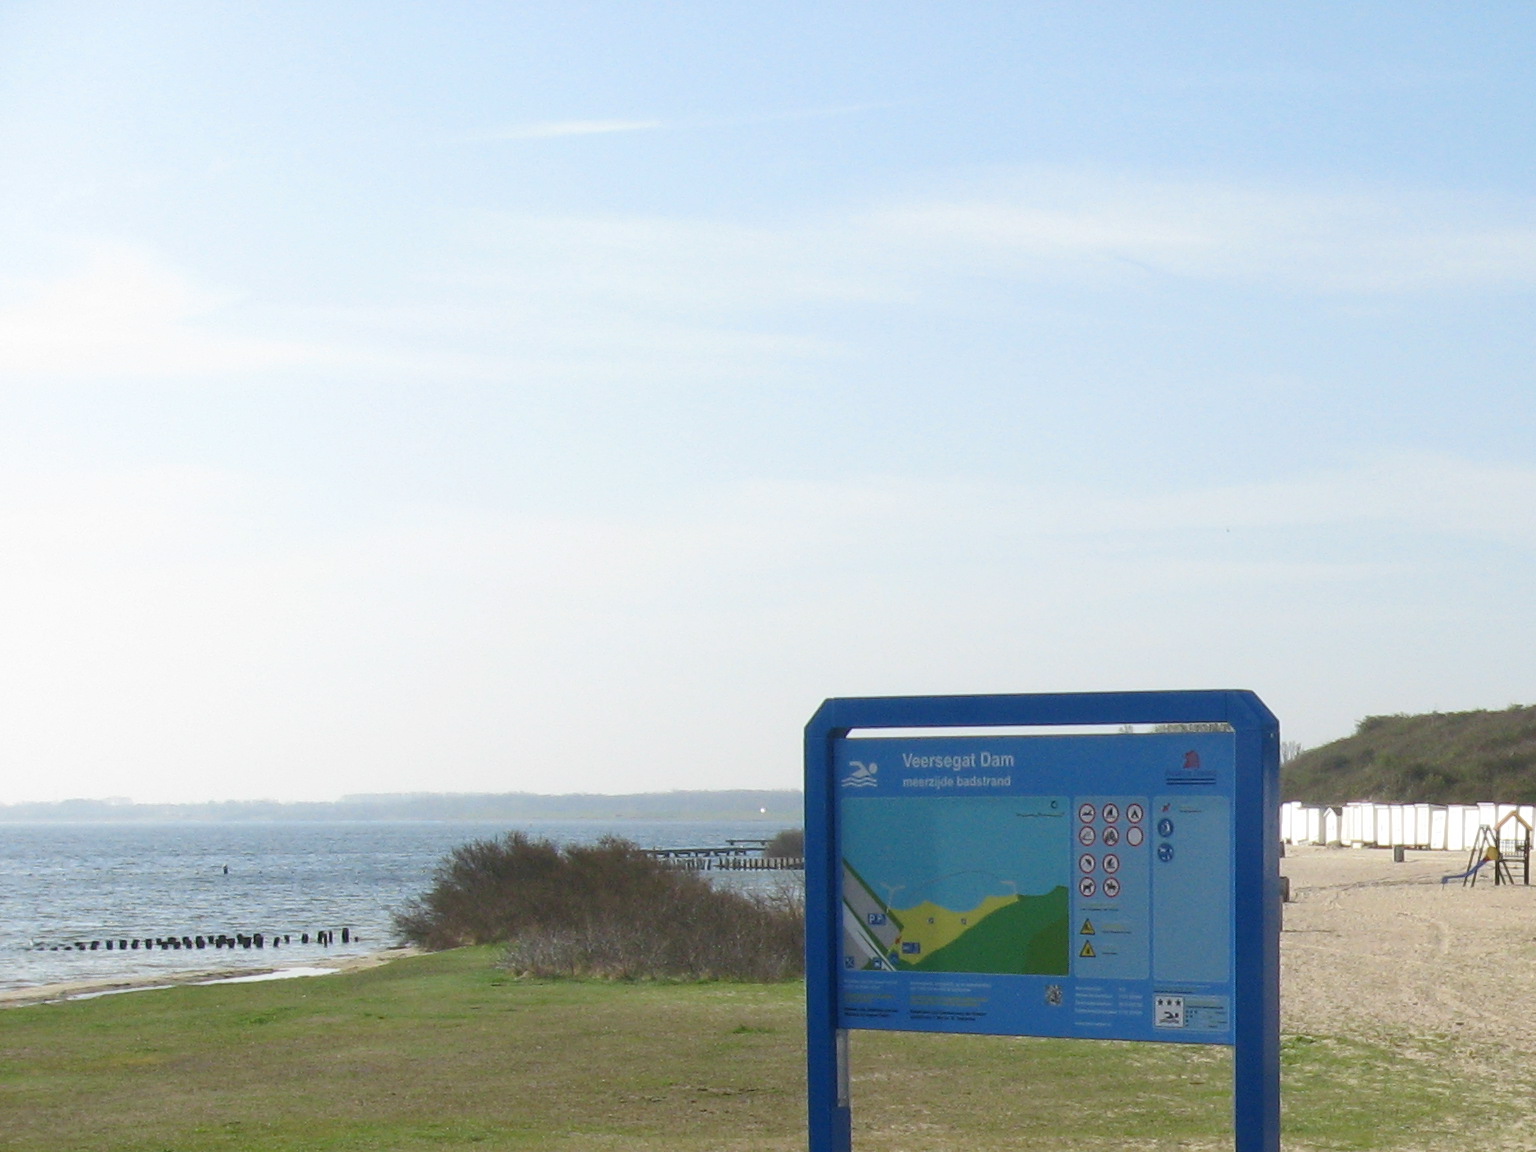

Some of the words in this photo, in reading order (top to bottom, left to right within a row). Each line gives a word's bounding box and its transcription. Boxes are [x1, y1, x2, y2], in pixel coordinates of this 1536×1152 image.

[902, 753, 976, 771] Veersegat
[980, 752, 1014, 768] Dam
[903, 777, 954, 789] meerzijde
[956, 776, 1011, 787] badstrand
